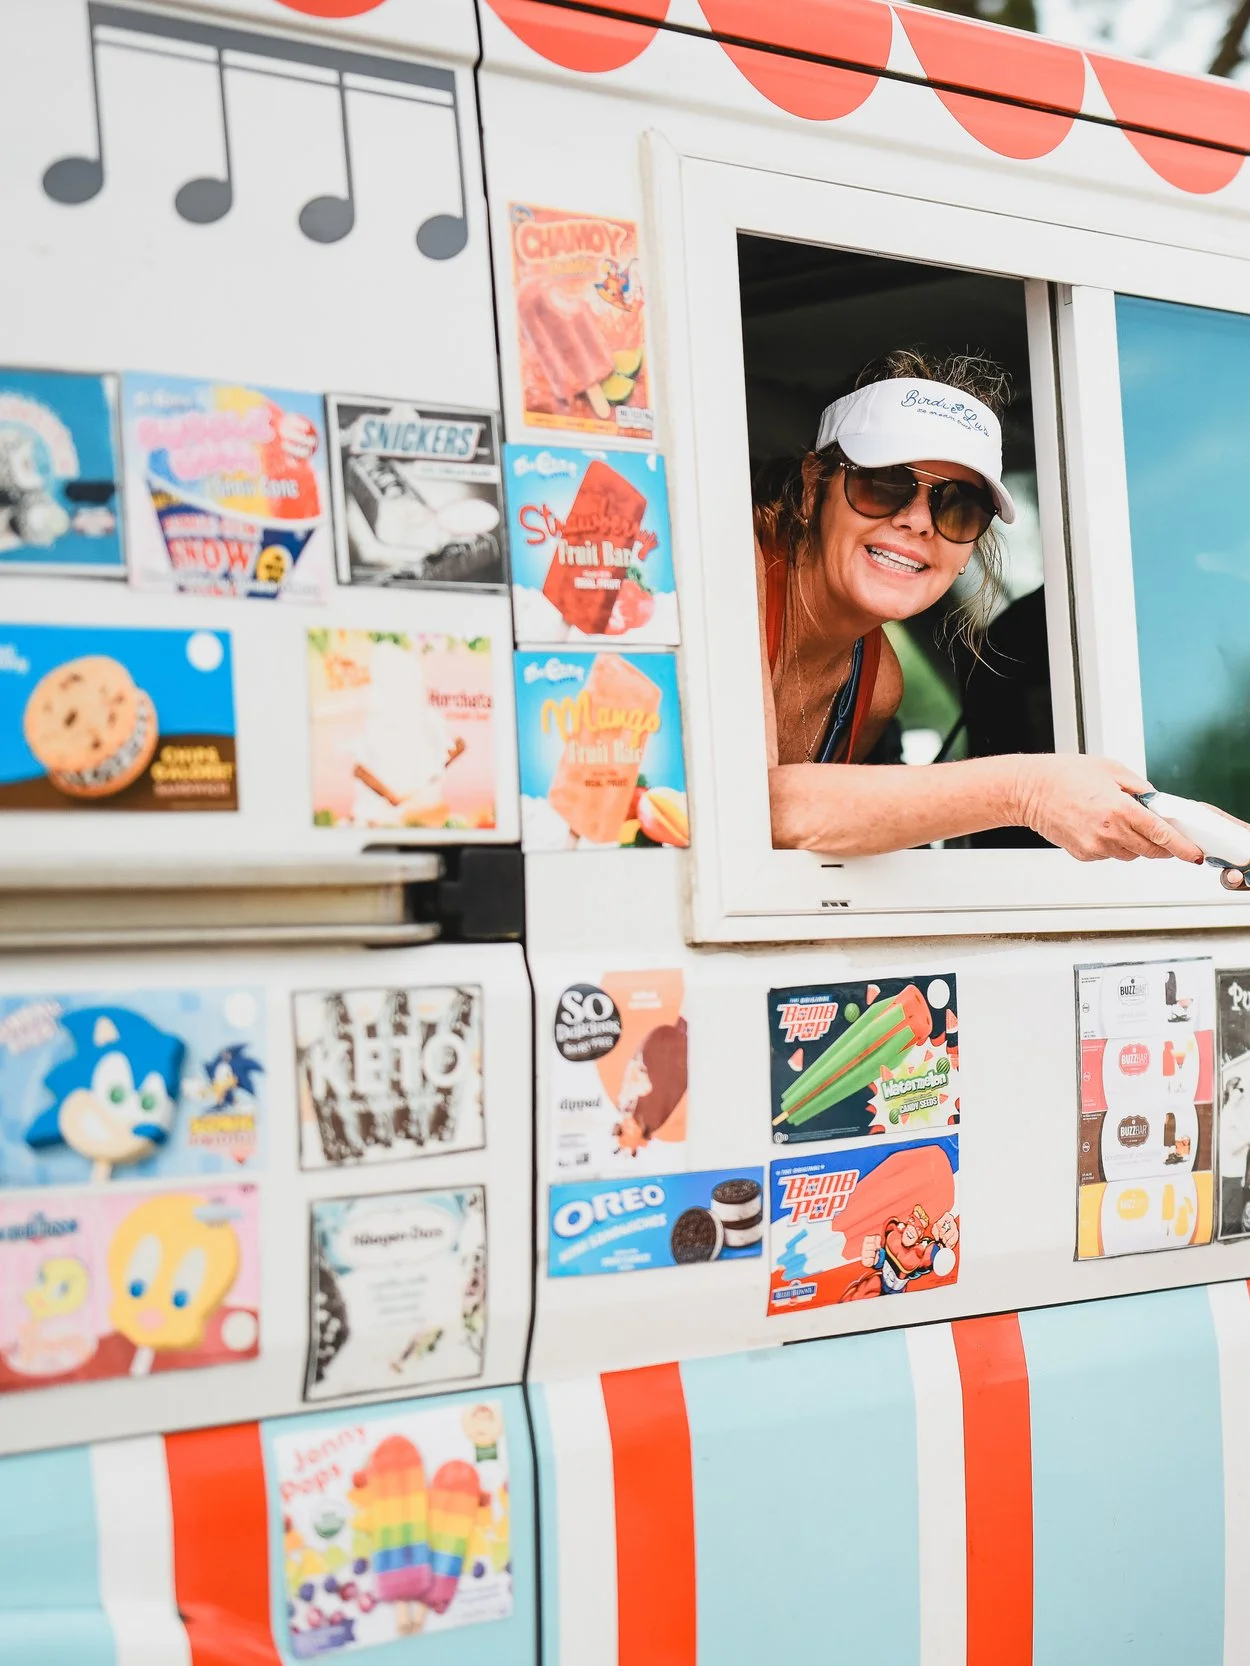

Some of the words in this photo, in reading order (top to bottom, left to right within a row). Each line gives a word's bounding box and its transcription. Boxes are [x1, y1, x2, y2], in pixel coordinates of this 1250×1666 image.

[359, 419, 474, 456] SNICKERS
[519, 504, 659, 561] Strawberry
[558, 539, 600, 567] Fruit
[541, 689, 662, 749] Mango
[568, 740, 609, 765] Fruit
[561, 990, 615, 1026] SO
[780, 1003, 837, 1023] BOMB
[782, 1021, 830, 1041] POP
[310, 1032, 464, 1100] KETO
[881, 1070, 948, 1101] Watermelon
[919, 1097, 939, 1110] SEEDS
[781, 1172, 858, 1200] BOMB
[553, 1184, 666, 1238] OREO
[783, 1194, 847, 1224] POP
